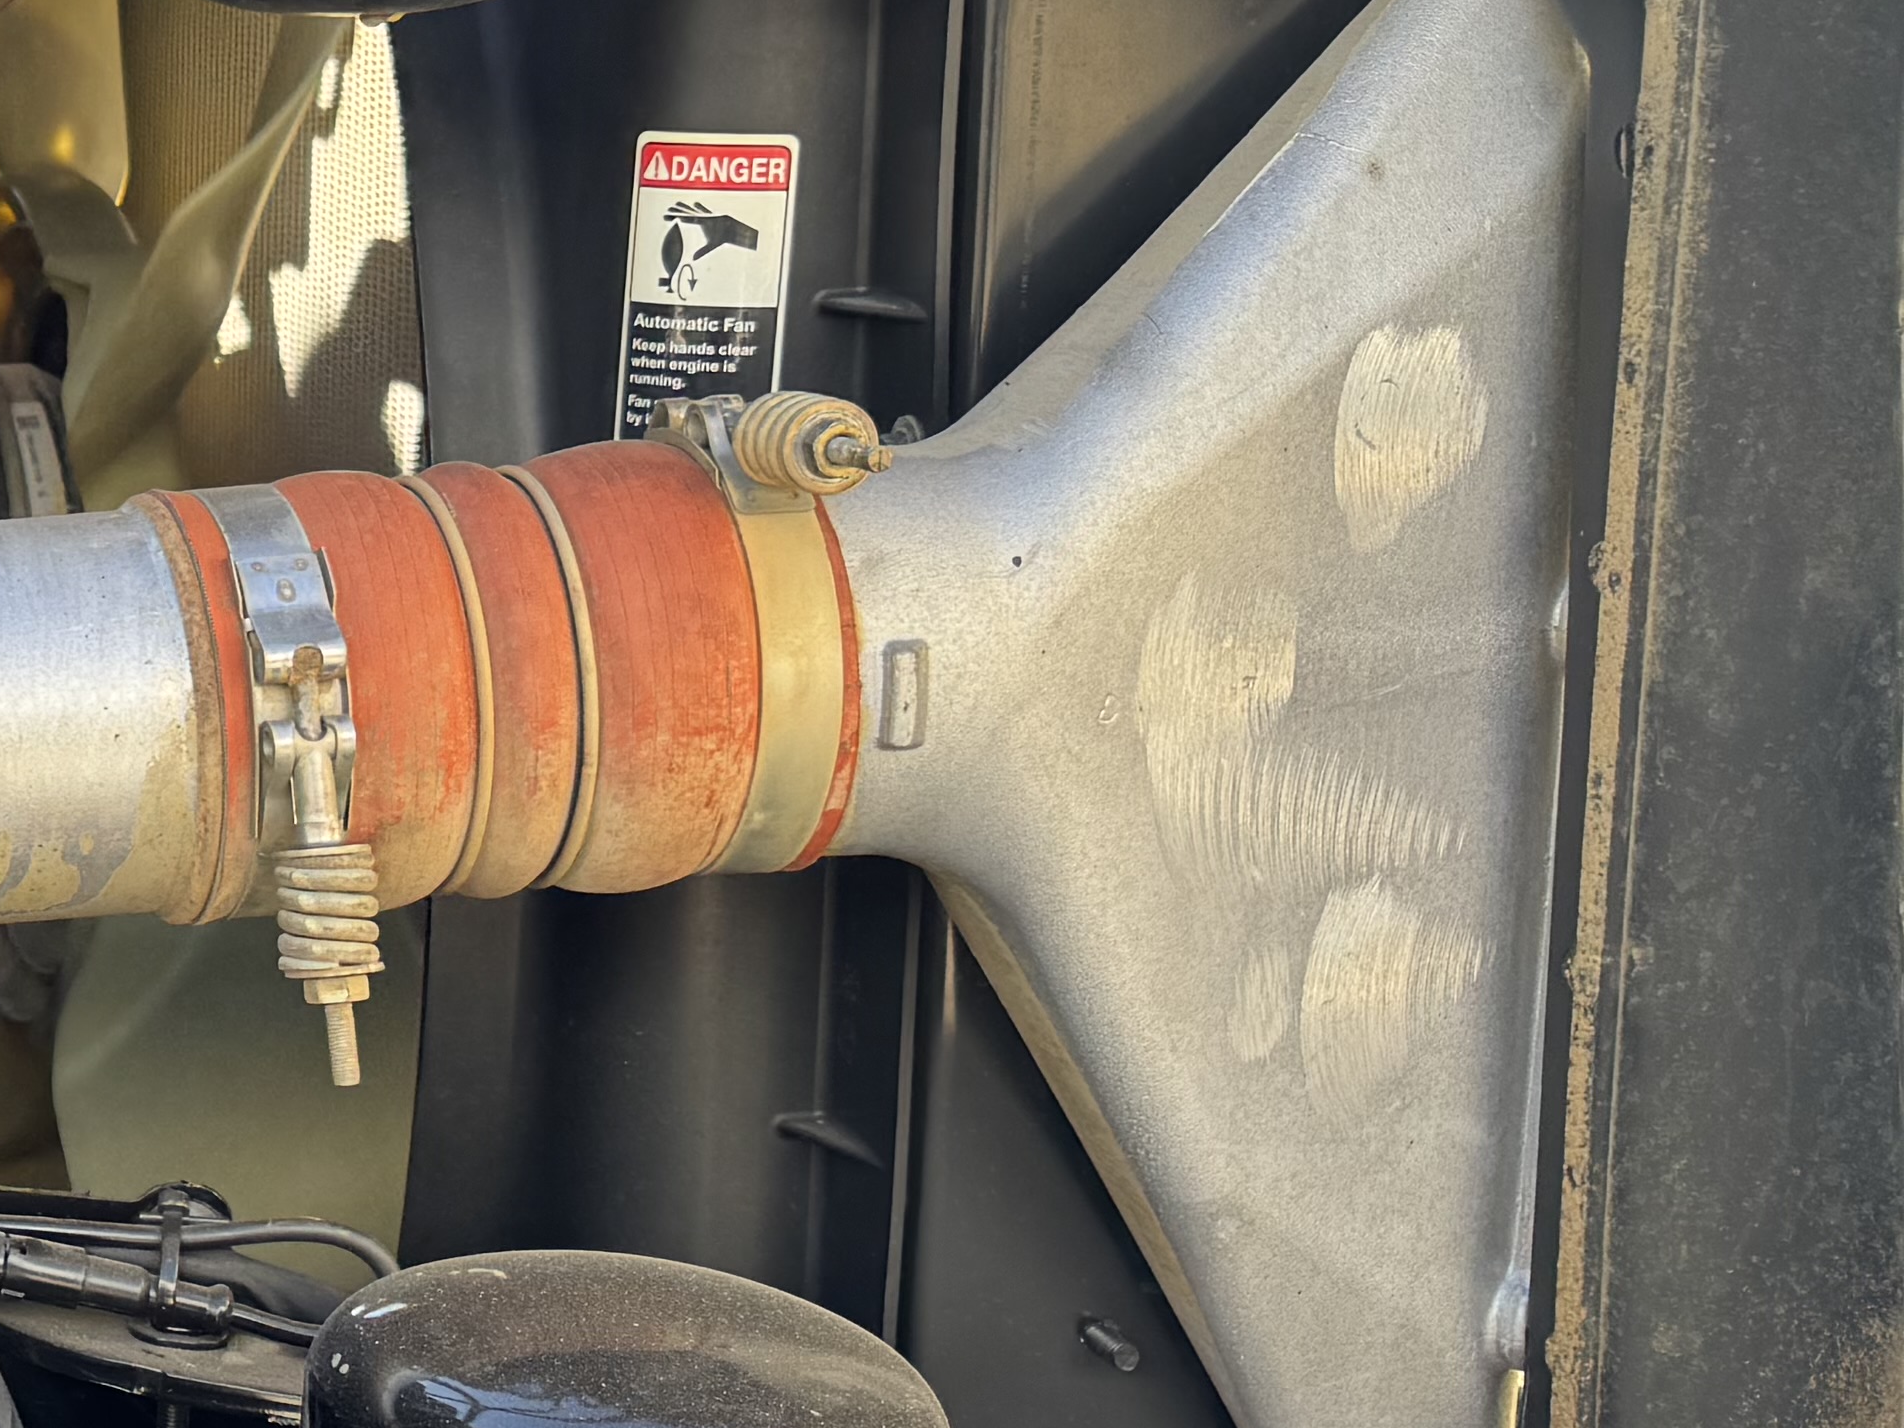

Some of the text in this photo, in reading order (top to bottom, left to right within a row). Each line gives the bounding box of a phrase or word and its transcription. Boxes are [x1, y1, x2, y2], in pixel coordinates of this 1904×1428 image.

[671, 155, 786, 184] DANGER
[633, 312, 756, 334] Automatic Fan
[631, 337, 757, 357] Keep hands clear
[630, 355, 737, 375] when engine is
[629, 372, 687, 390] running.
[627, 393, 652, 409] Fan
[626, 410, 643, 427] by
